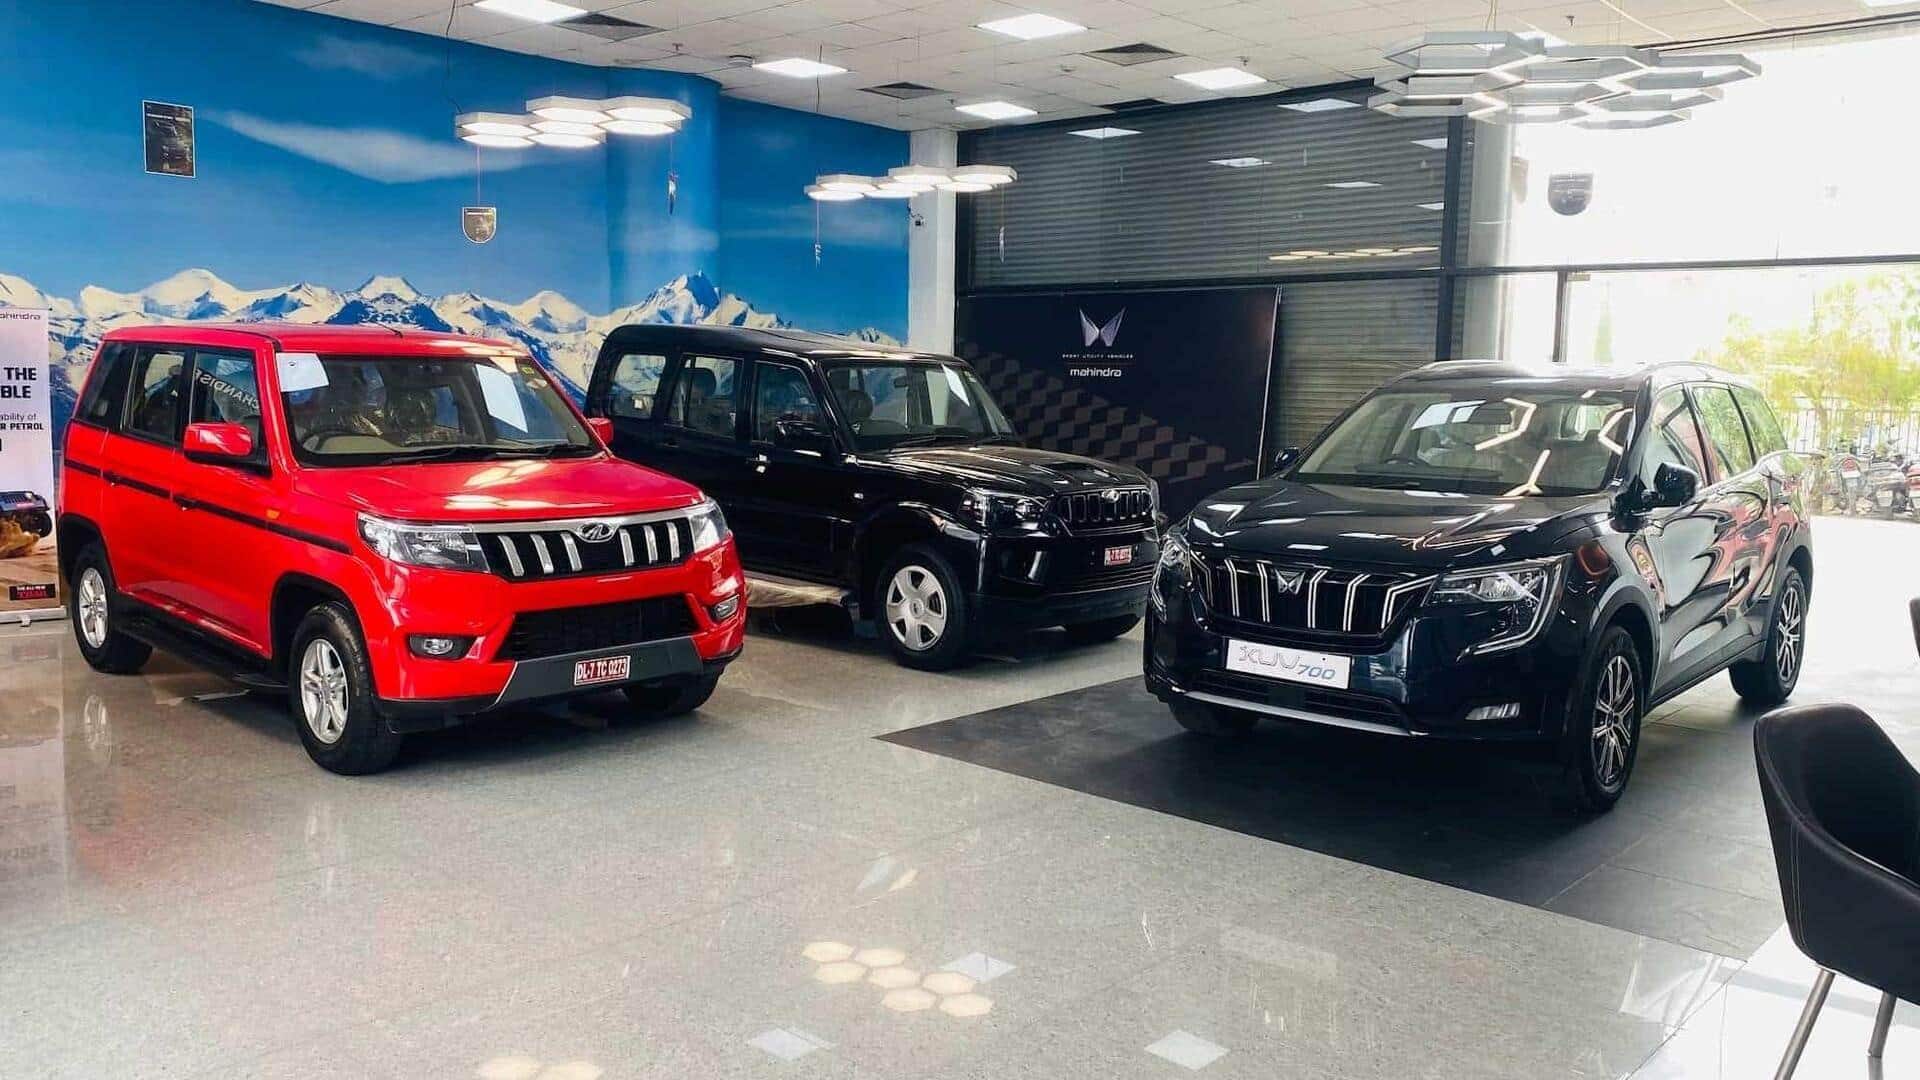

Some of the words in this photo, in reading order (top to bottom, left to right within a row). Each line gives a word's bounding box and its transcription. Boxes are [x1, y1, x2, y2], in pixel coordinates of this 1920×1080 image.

[3, 367, 37, 381] THE
[1069, 367, 1122, 377] mahindra
[0, 385, 32, 399] BLE
[10, 422, 44, 431] PETROL
